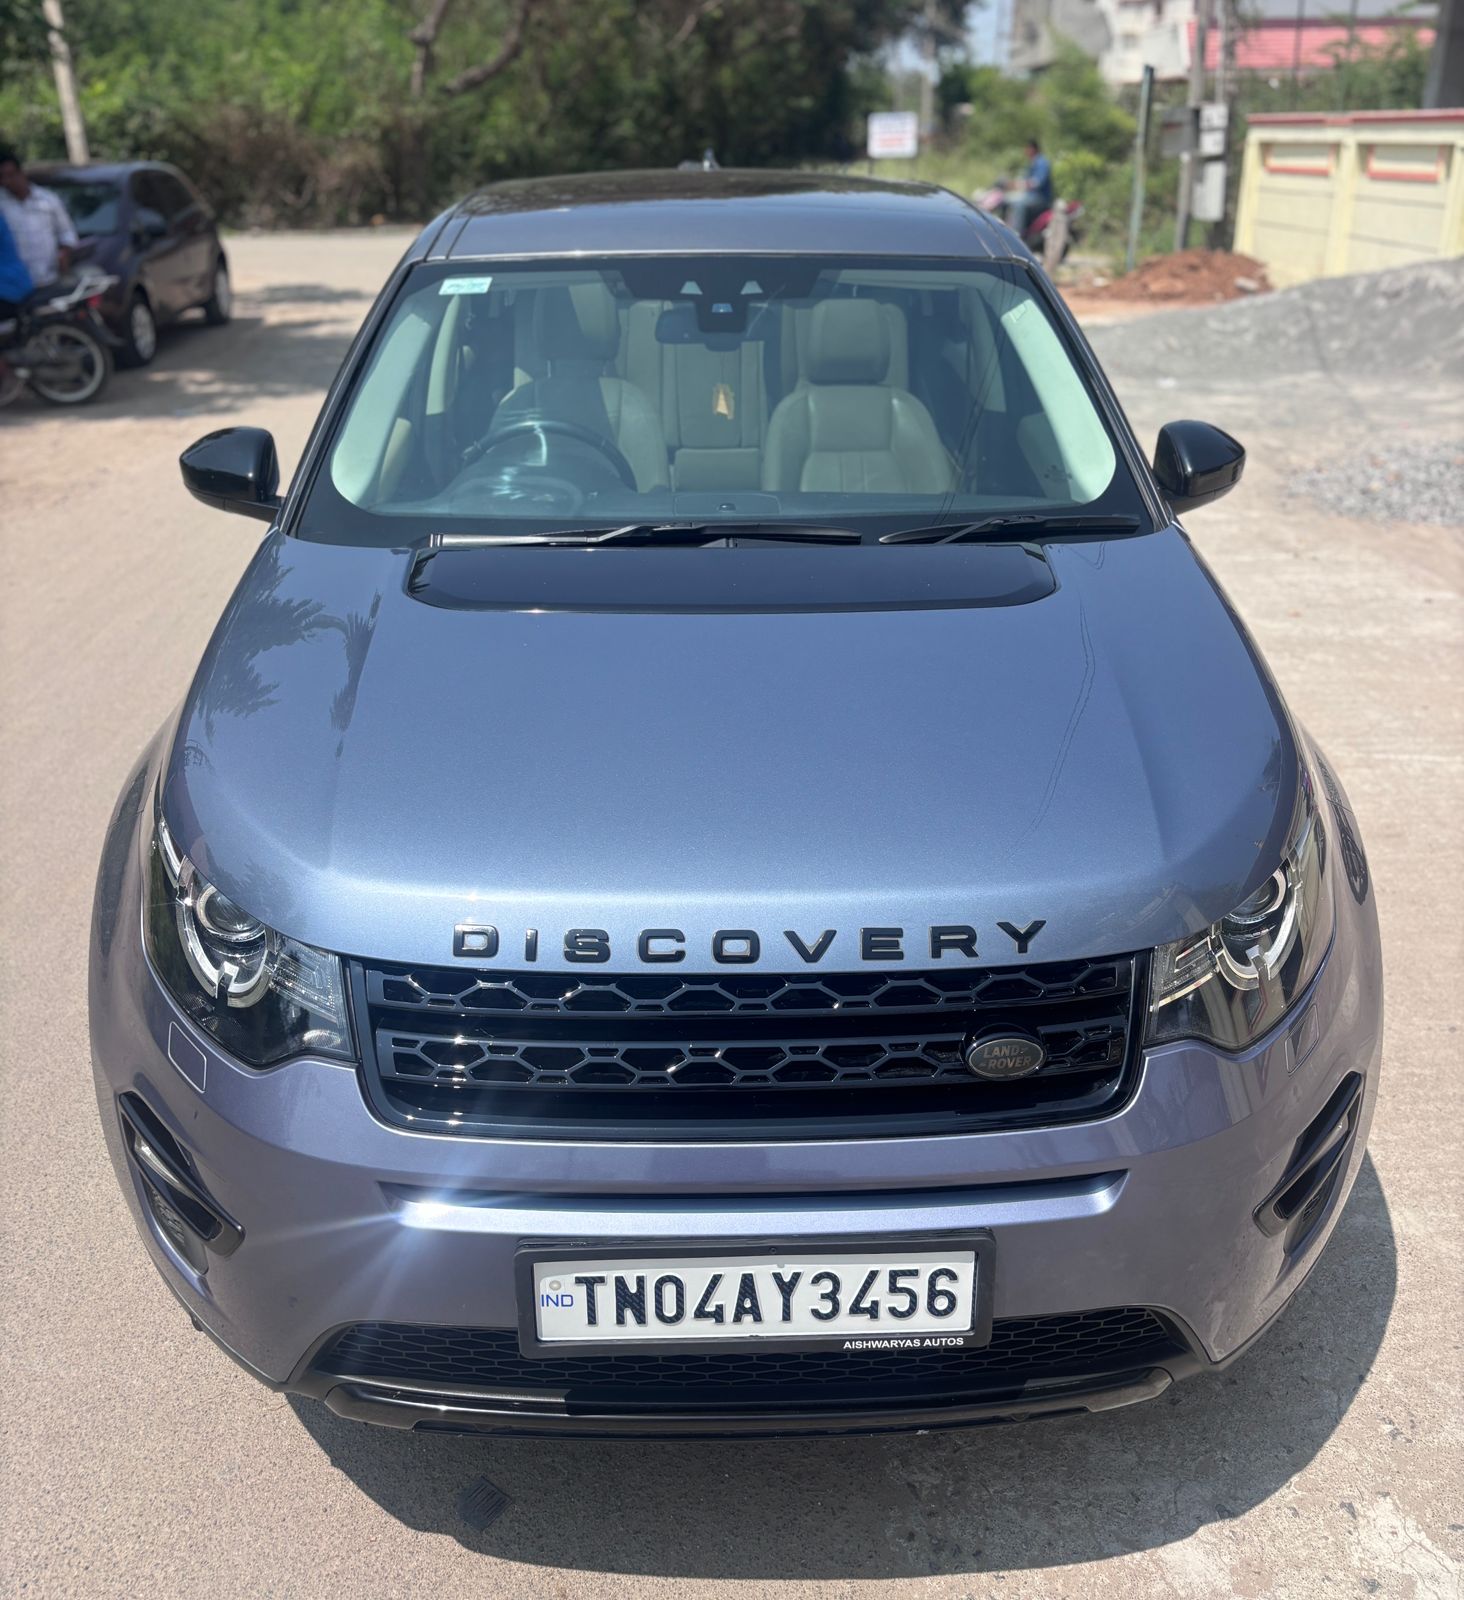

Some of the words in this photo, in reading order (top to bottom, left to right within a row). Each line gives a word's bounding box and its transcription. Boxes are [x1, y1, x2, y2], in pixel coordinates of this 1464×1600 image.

[452, 920, 1047, 964] DISCOVERY
[983, 1044, 1021, 1059] LAND
[987, 1056, 1032, 1070] ROVER
[540, 1294, 574, 1307] IND
[574, 1266, 959, 1326] TN04AY3456
[843, 1339, 921, 1350] AISHWARYAS
[923, 1337, 965, 1347] AUTOS
